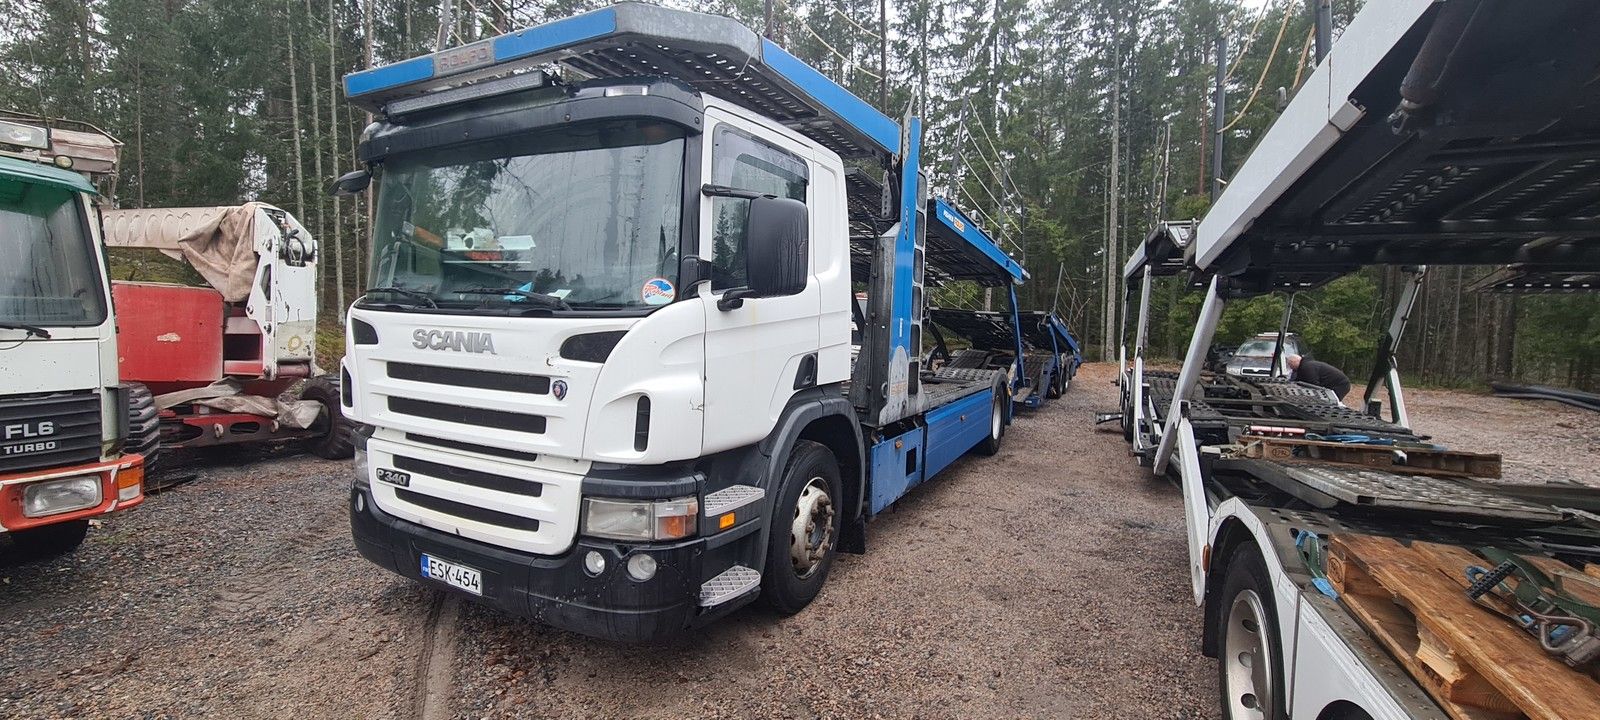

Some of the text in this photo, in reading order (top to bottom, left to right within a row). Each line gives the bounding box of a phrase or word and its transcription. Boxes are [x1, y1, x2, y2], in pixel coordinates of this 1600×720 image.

[412, 328, 497, 355] SCANIA
[5, 421, 54, 439] FL6
[3, 441, 56, 454] TURBO
[430, 560, 479, 590] ESK-454
